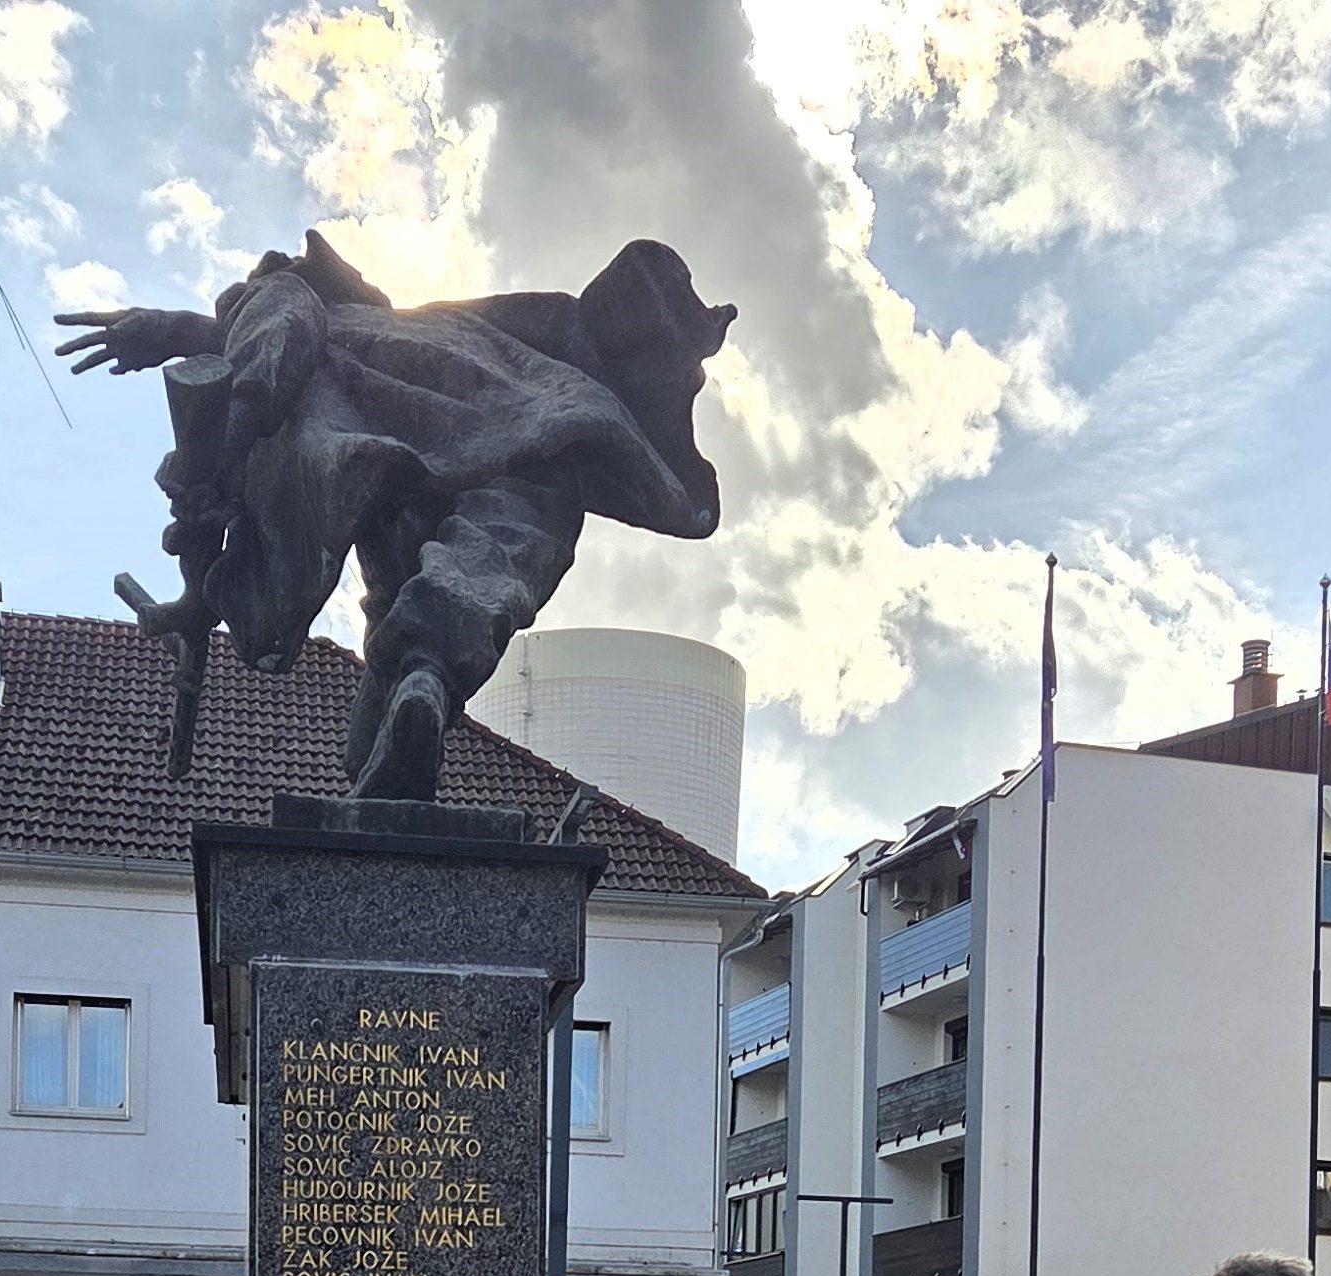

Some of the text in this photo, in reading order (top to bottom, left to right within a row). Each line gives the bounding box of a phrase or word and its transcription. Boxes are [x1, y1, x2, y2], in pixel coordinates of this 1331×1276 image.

[359, 1009, 440, 1031] RAVNE
[283, 1037, 479, 1066] KLANČNIK IVAN
[283, 1065, 506, 1090] PUNGERTNIK IVAN
[285, 1090, 440, 1108] MEH ANTON
[283, 1109, 471, 1134] POTOČNIK JOŽE
[283, 1133, 481, 1157] SOVIČ ZDRAVKO
[283, 1156, 443, 1180] SOVIČ ALOJZ
[282, 1180, 491, 1203] HUDOURNIK JOŽE
[282, 1201, 506, 1226] HRIBERŠEK MIHAEL
[281, 1224, 473, 1248] PEČOVNIK IVAN
[282, 1248, 408, 1270] ŽAK JOŽE
